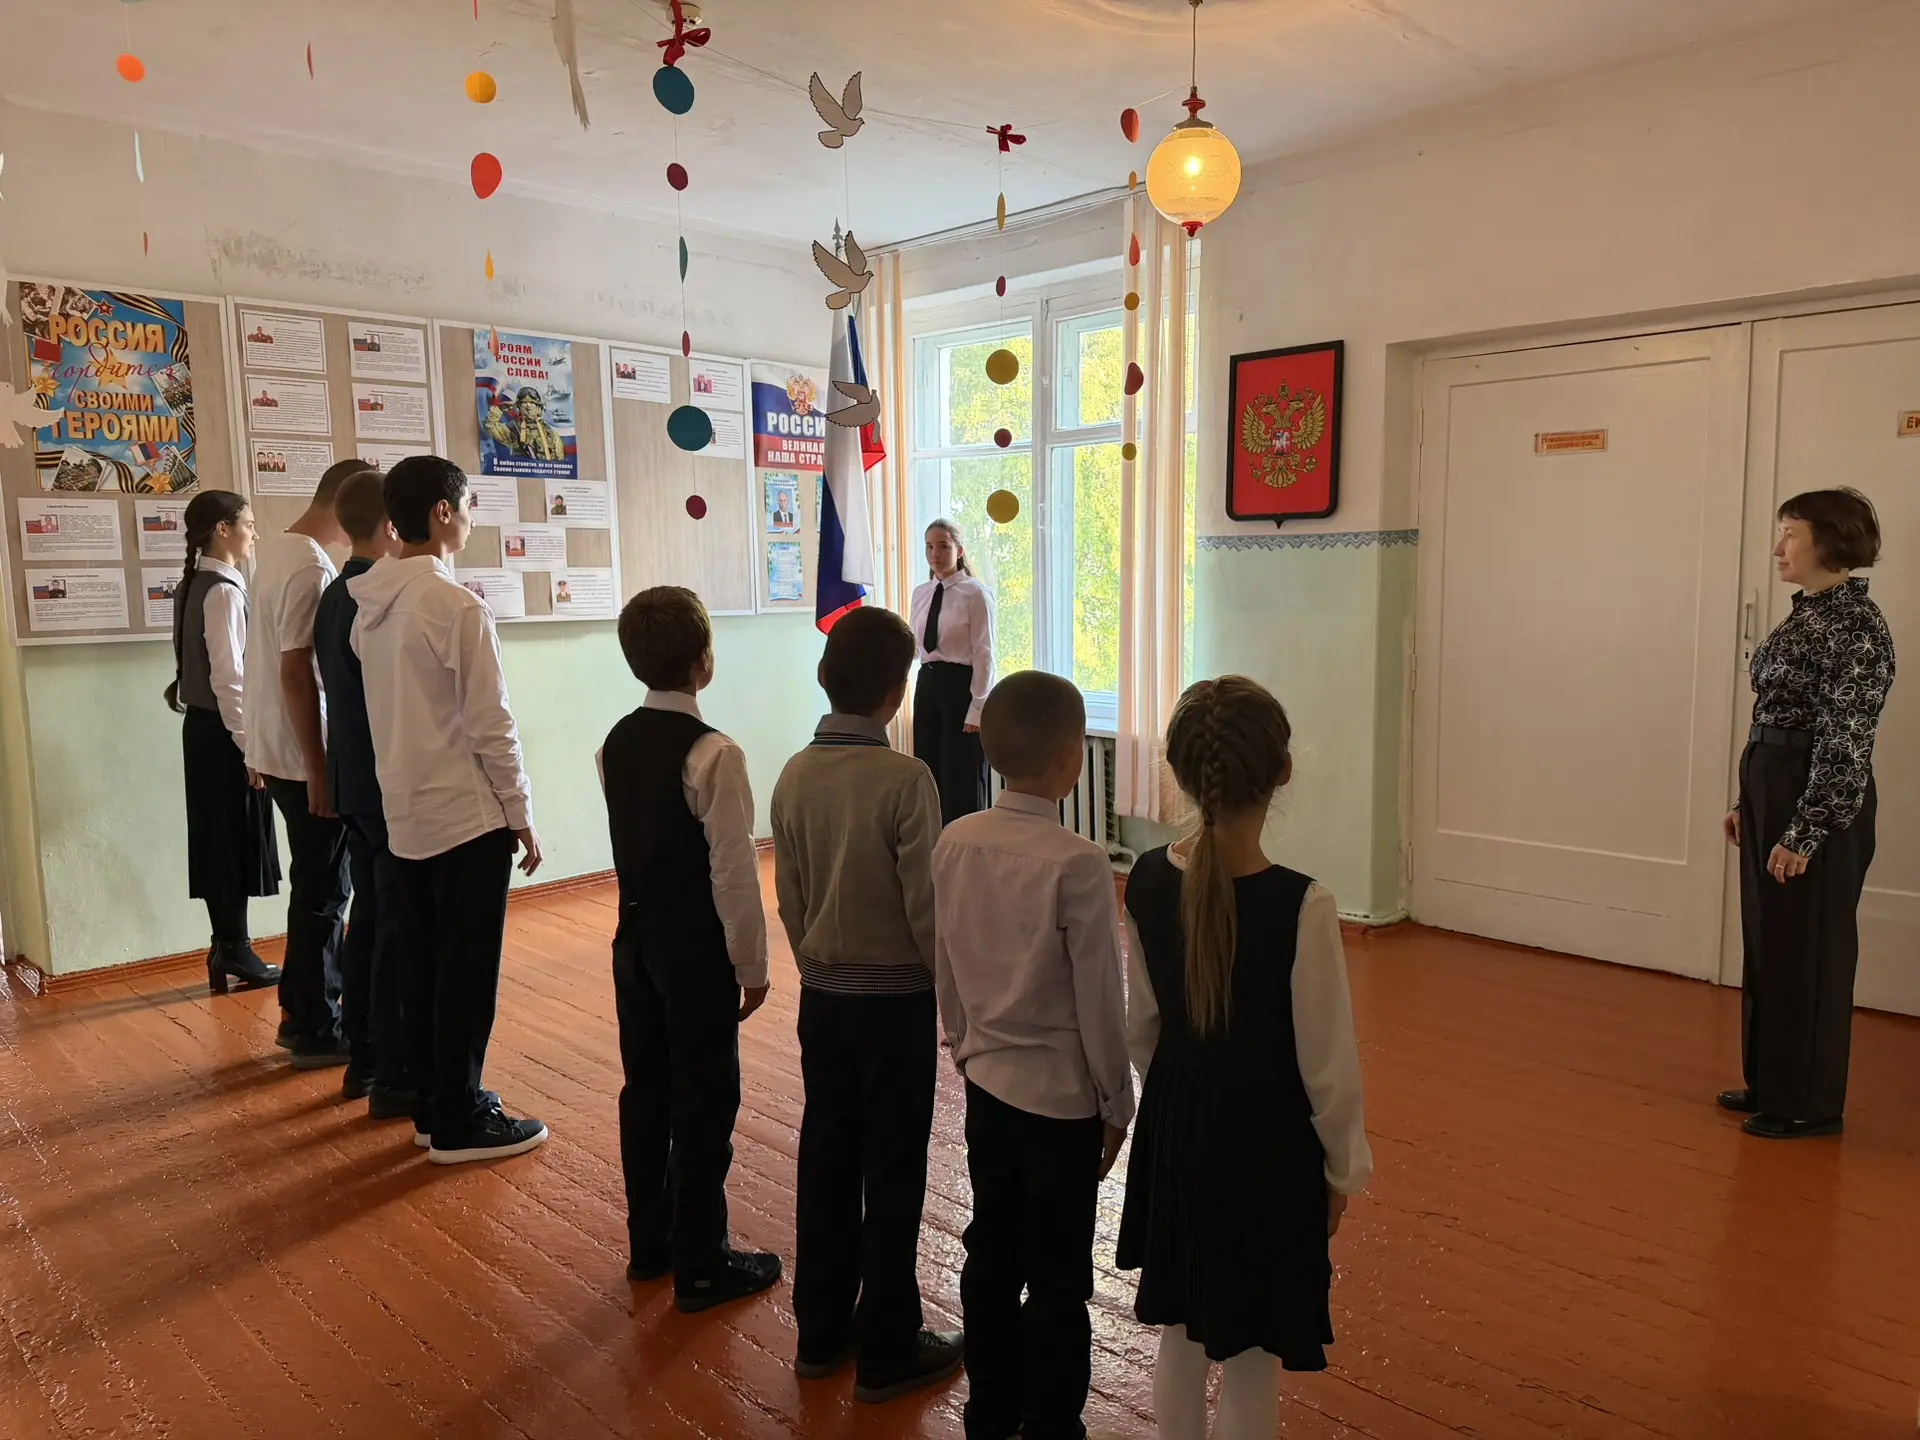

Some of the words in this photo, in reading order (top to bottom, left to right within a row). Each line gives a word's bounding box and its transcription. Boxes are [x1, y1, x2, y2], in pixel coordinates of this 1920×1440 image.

[49, 314, 166, 353] РОССИЯ
[488, 341, 532, 354] РОЯМ
[496, 354, 541, 367] РОССИИ
[51, 342, 180, 404] гордится
[507, 367, 549, 380] СЛАВА!
[74, 390, 154, 412] СВОИМИ
[767, 411, 826, 437] РОССИ
[782, 440, 825, 454] ВЕЛИКАЯ
[768, 451, 795, 464] НАША
[799, 453, 823, 466] СТРА
